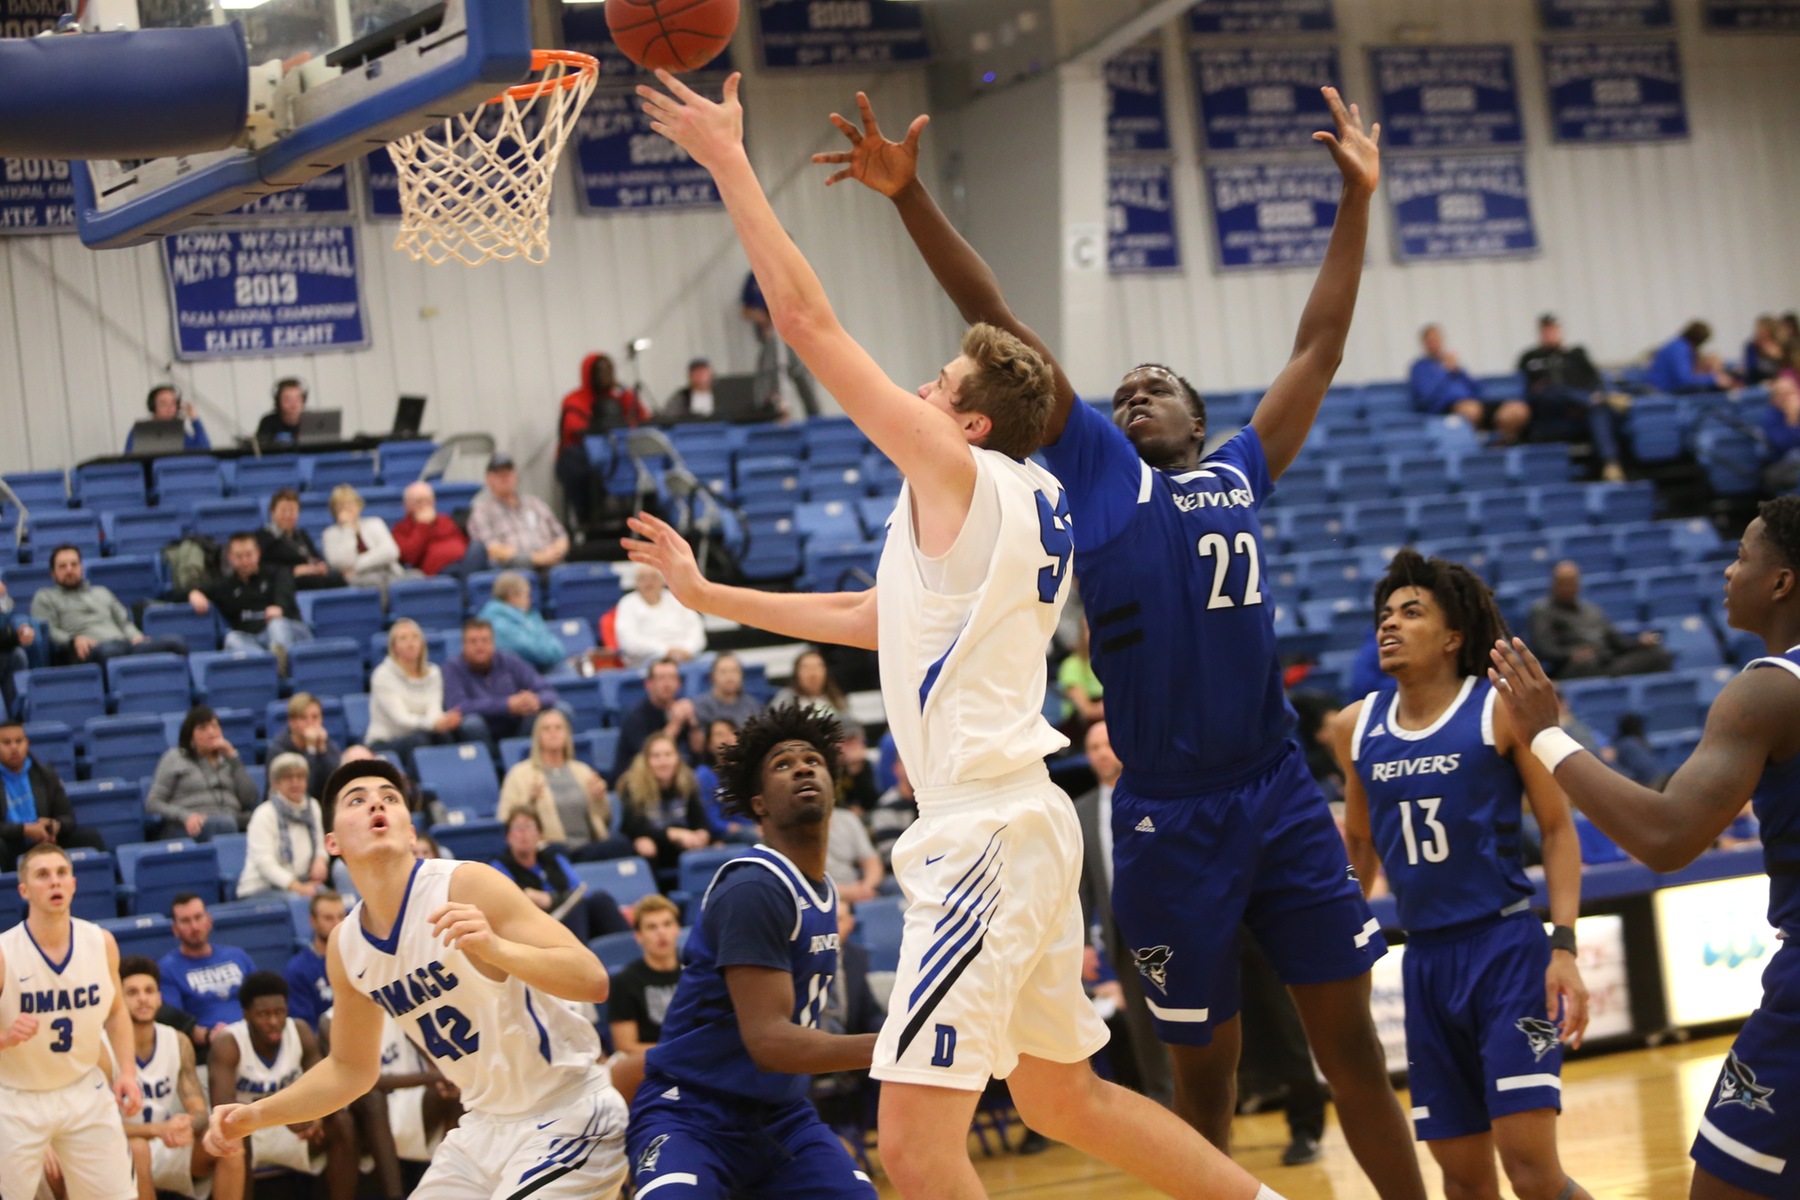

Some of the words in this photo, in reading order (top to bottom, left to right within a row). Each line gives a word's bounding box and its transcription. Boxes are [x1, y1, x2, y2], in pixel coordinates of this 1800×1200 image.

[240, 227, 345, 248] WESTERN
[236, 246, 354, 277] BASKETBALL
[234, 272, 298, 307] 2013
[205, 328, 265, 350] ELITE
[272, 322, 335, 346] EIGHT
[1198, 532, 1262, 610] 22
[1371, 753, 1461, 782] REIVERS
[1398, 797, 1450, 865] 13
[20, 983, 100, 1014] DMACC
[50, 1017, 73, 1053] 3
[416, 1005, 480, 1062] 42
[931, 1023, 957, 1067] D
